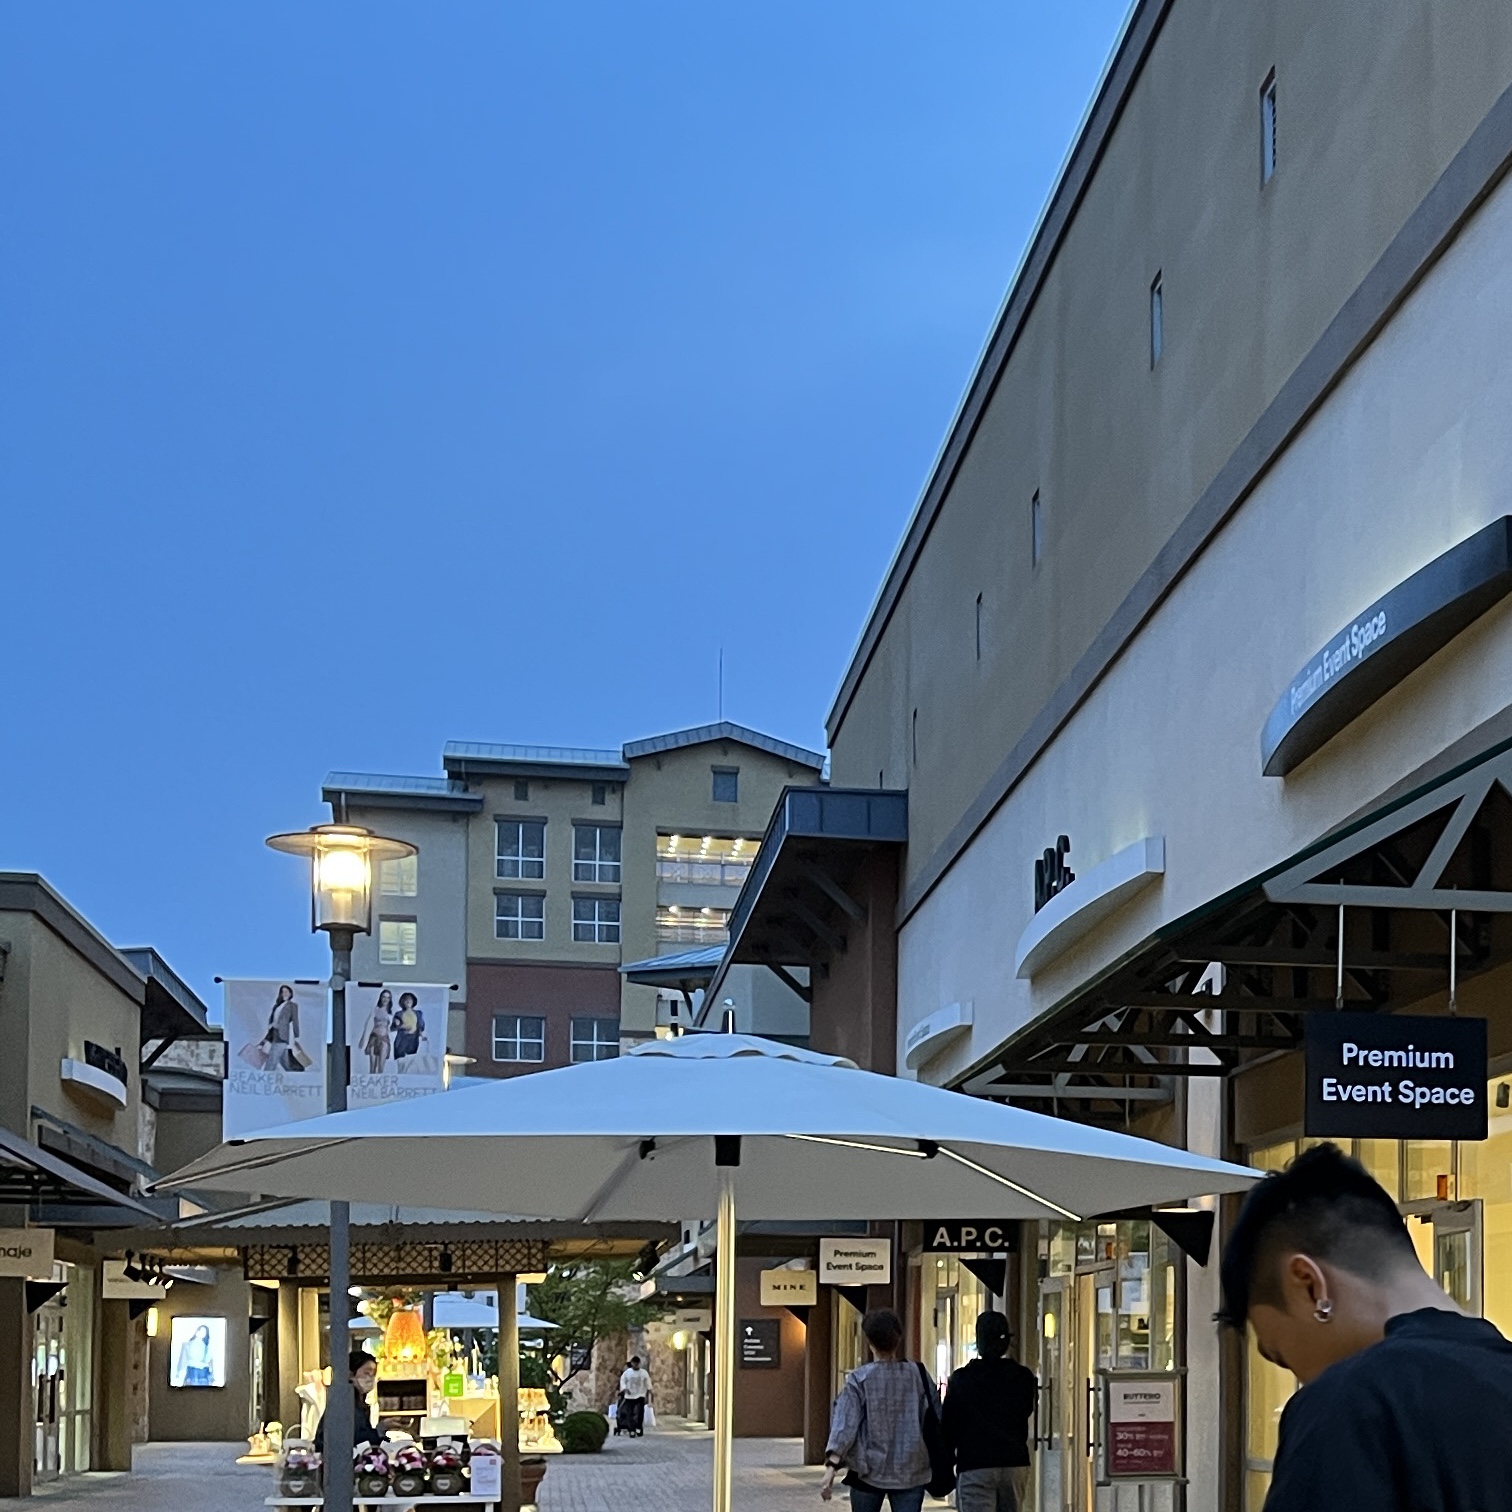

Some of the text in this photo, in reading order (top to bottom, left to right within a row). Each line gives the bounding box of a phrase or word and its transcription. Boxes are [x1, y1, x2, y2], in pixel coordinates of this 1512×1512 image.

[1323, 650, 1351, 681] Event
[1351, 611, 1386, 659] Space
[1342, 1042, 1455, 1069] Premium
[230, 1071, 285, 1085] BEAKER
[351, 1075, 399, 1088] BEAKER
[229, 1084, 323, 1098] NEIL BARRETT
[351, 1087, 379, 1099] NEIL
[1322, 1077, 1475, 1108] Event Space
[932, 1226, 1010, 1248] A.P.C.
[833, 1249, 877, 1259] Premium
[826, 1262, 884, 1273] Event Space
[772, 1283, 807, 1291] MINE
